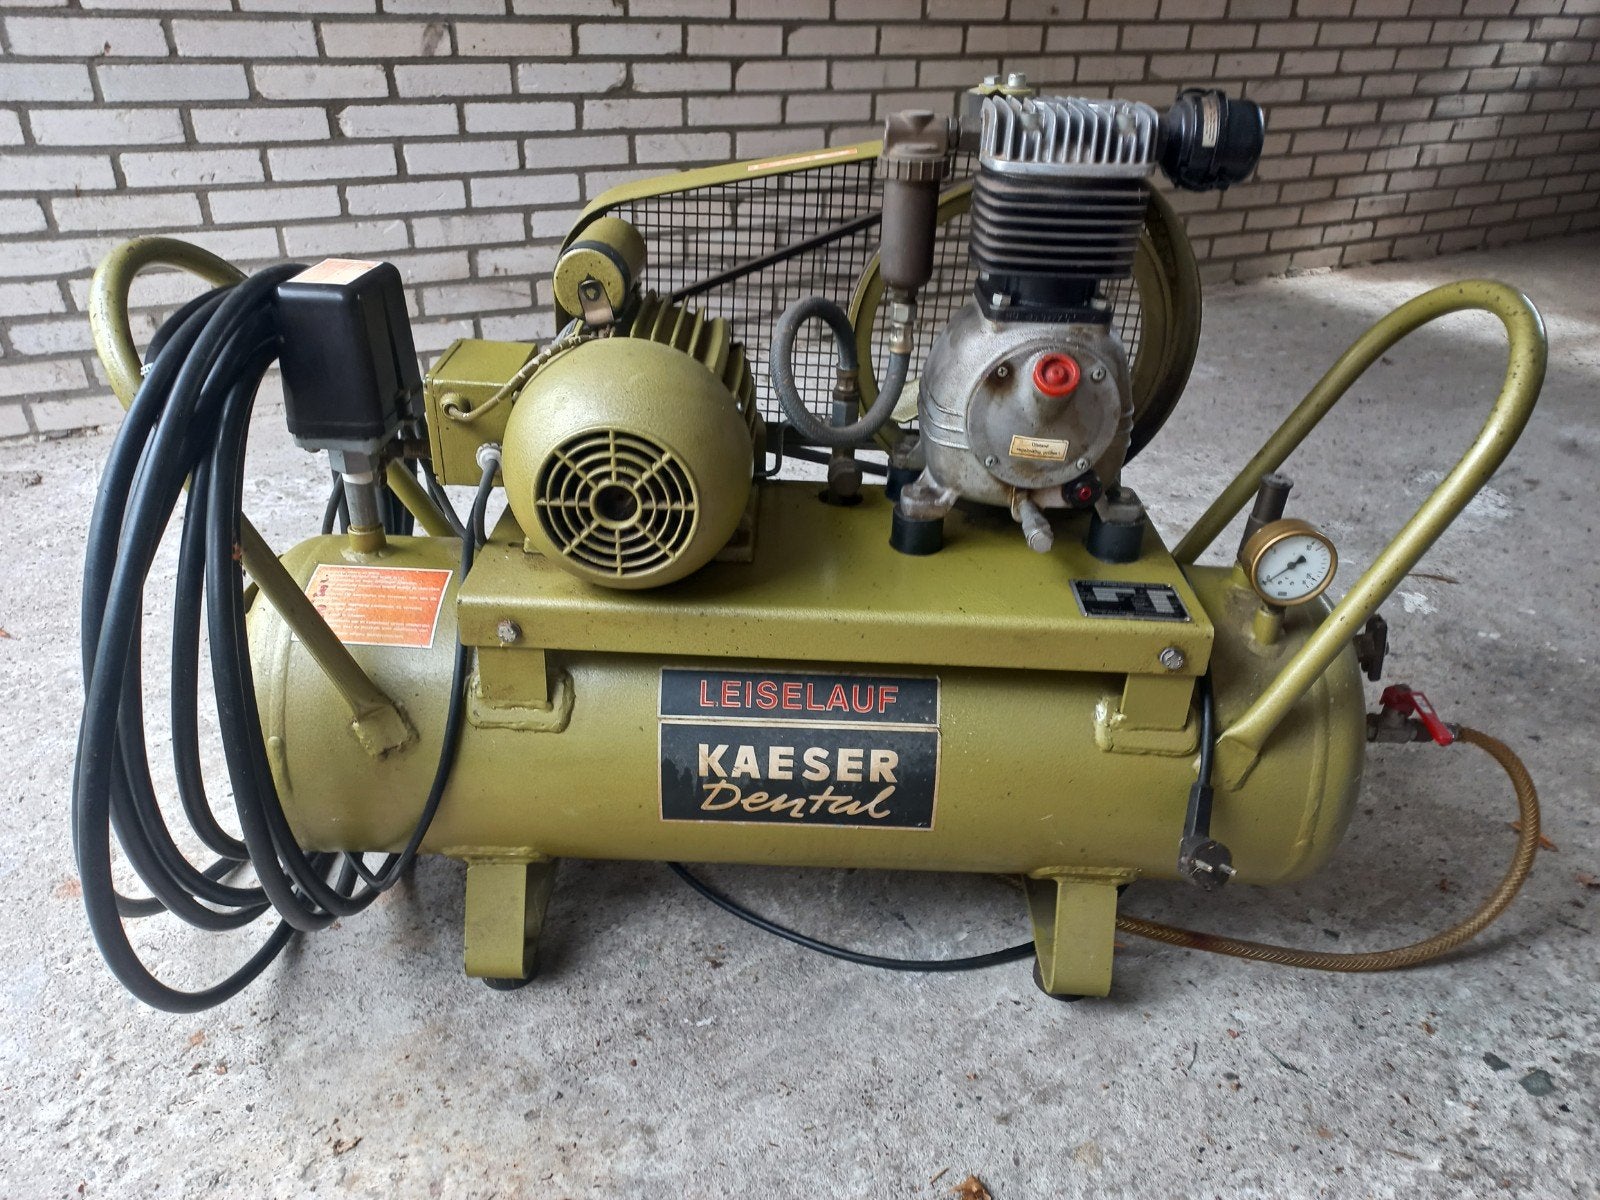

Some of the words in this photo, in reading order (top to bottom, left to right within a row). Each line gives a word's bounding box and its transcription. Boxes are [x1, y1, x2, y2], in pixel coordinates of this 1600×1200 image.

[700, 679, 899, 714] LEISELAUF
[698, 743, 899, 783] KAESER
[700, 779, 896, 819] Dental
